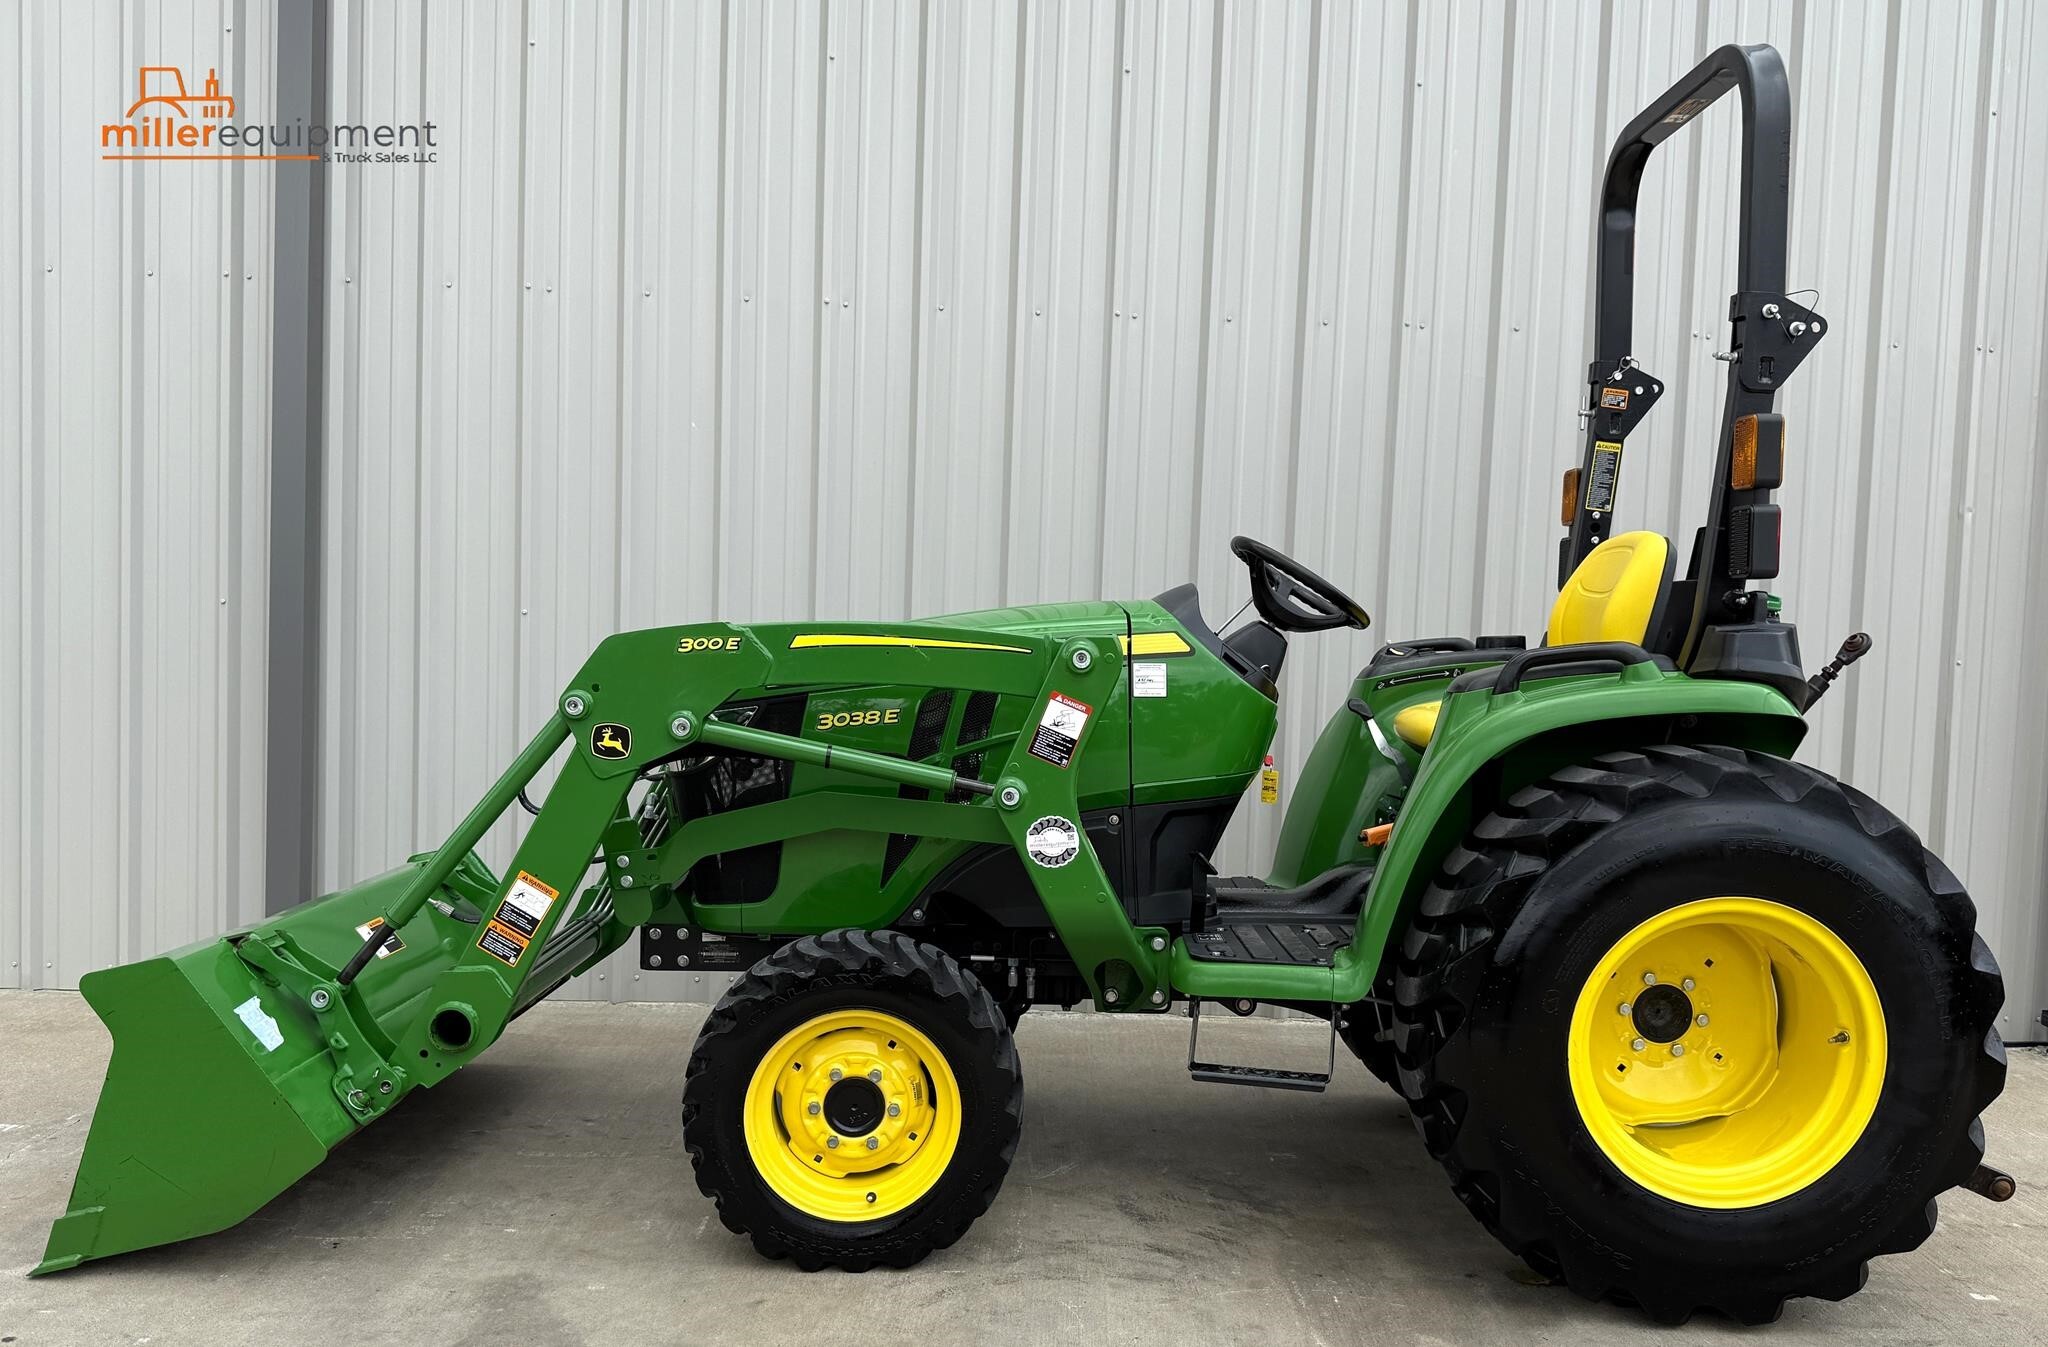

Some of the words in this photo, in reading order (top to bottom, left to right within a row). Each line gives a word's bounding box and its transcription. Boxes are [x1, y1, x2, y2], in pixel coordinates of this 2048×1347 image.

[1063, 698, 1086, 712] DANGER
[528, 878, 553, 896] WARNING
[499, 927, 525, 945] WARNING
